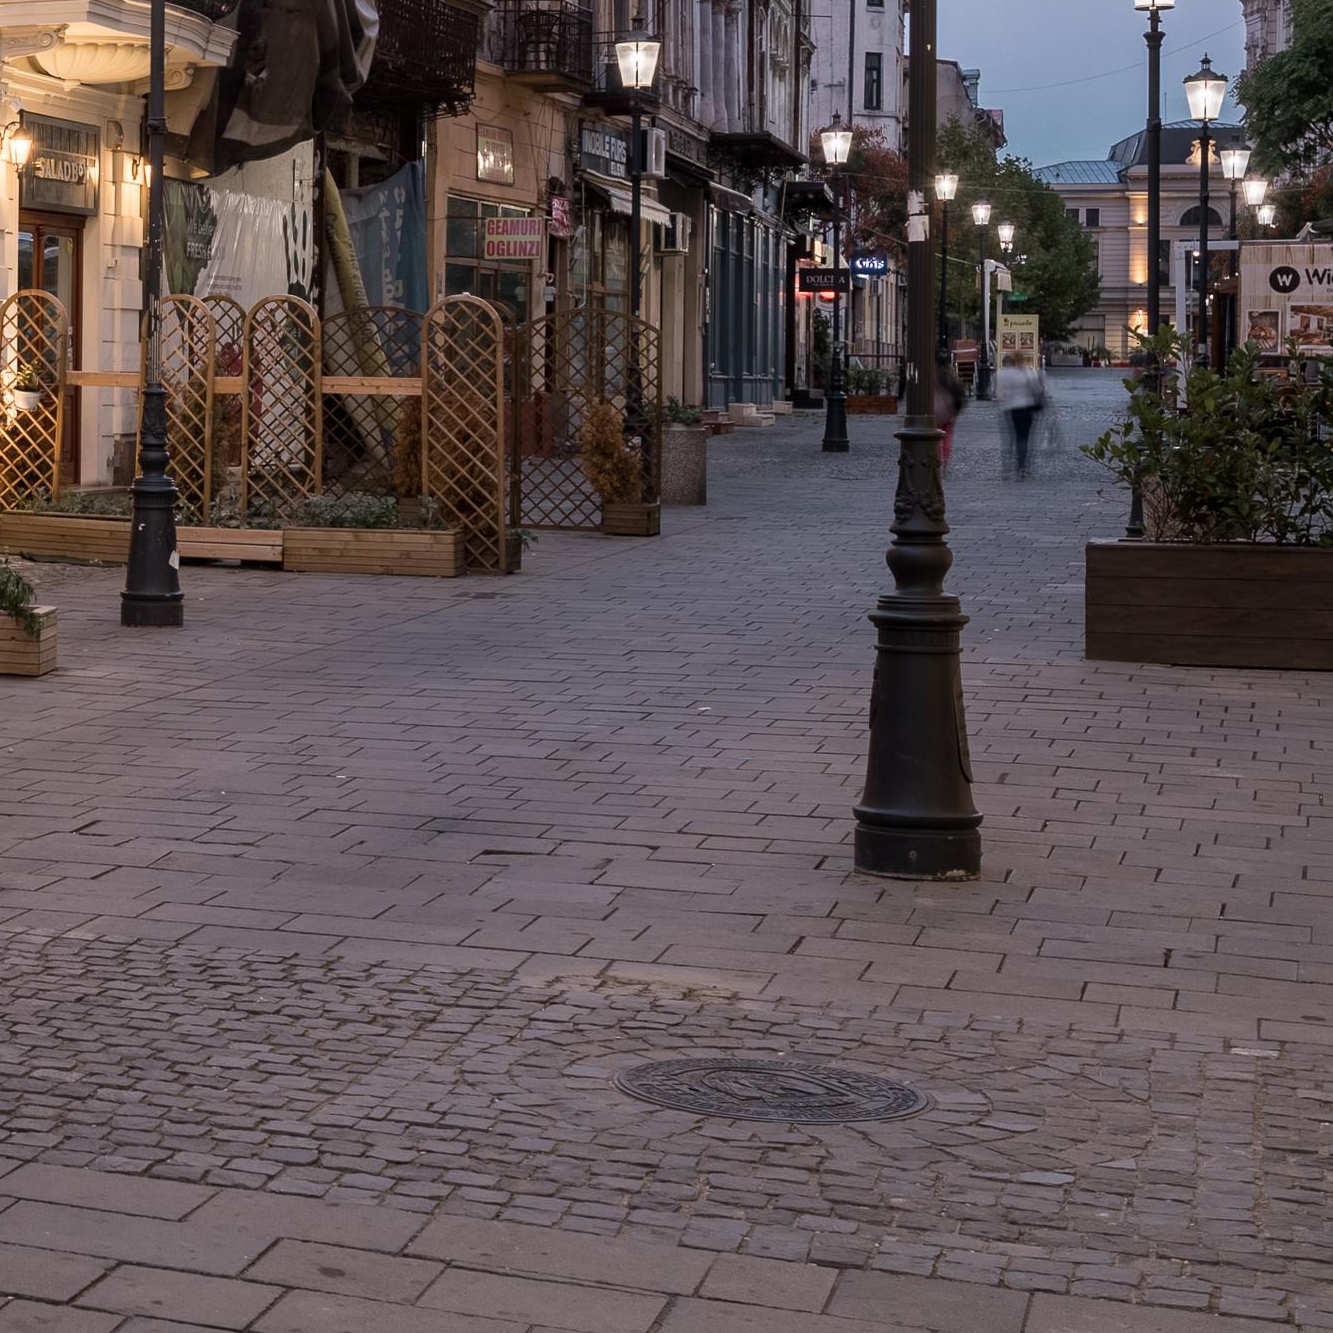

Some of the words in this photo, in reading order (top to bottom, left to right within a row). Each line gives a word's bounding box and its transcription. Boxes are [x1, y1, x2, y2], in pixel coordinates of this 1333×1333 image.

[487, 219, 541, 235] GEAMURI
[486, 240, 540, 257] OGLINZI
[1277, 274, 1292, 286] W
[1305, 268, 1333, 285] Wi
